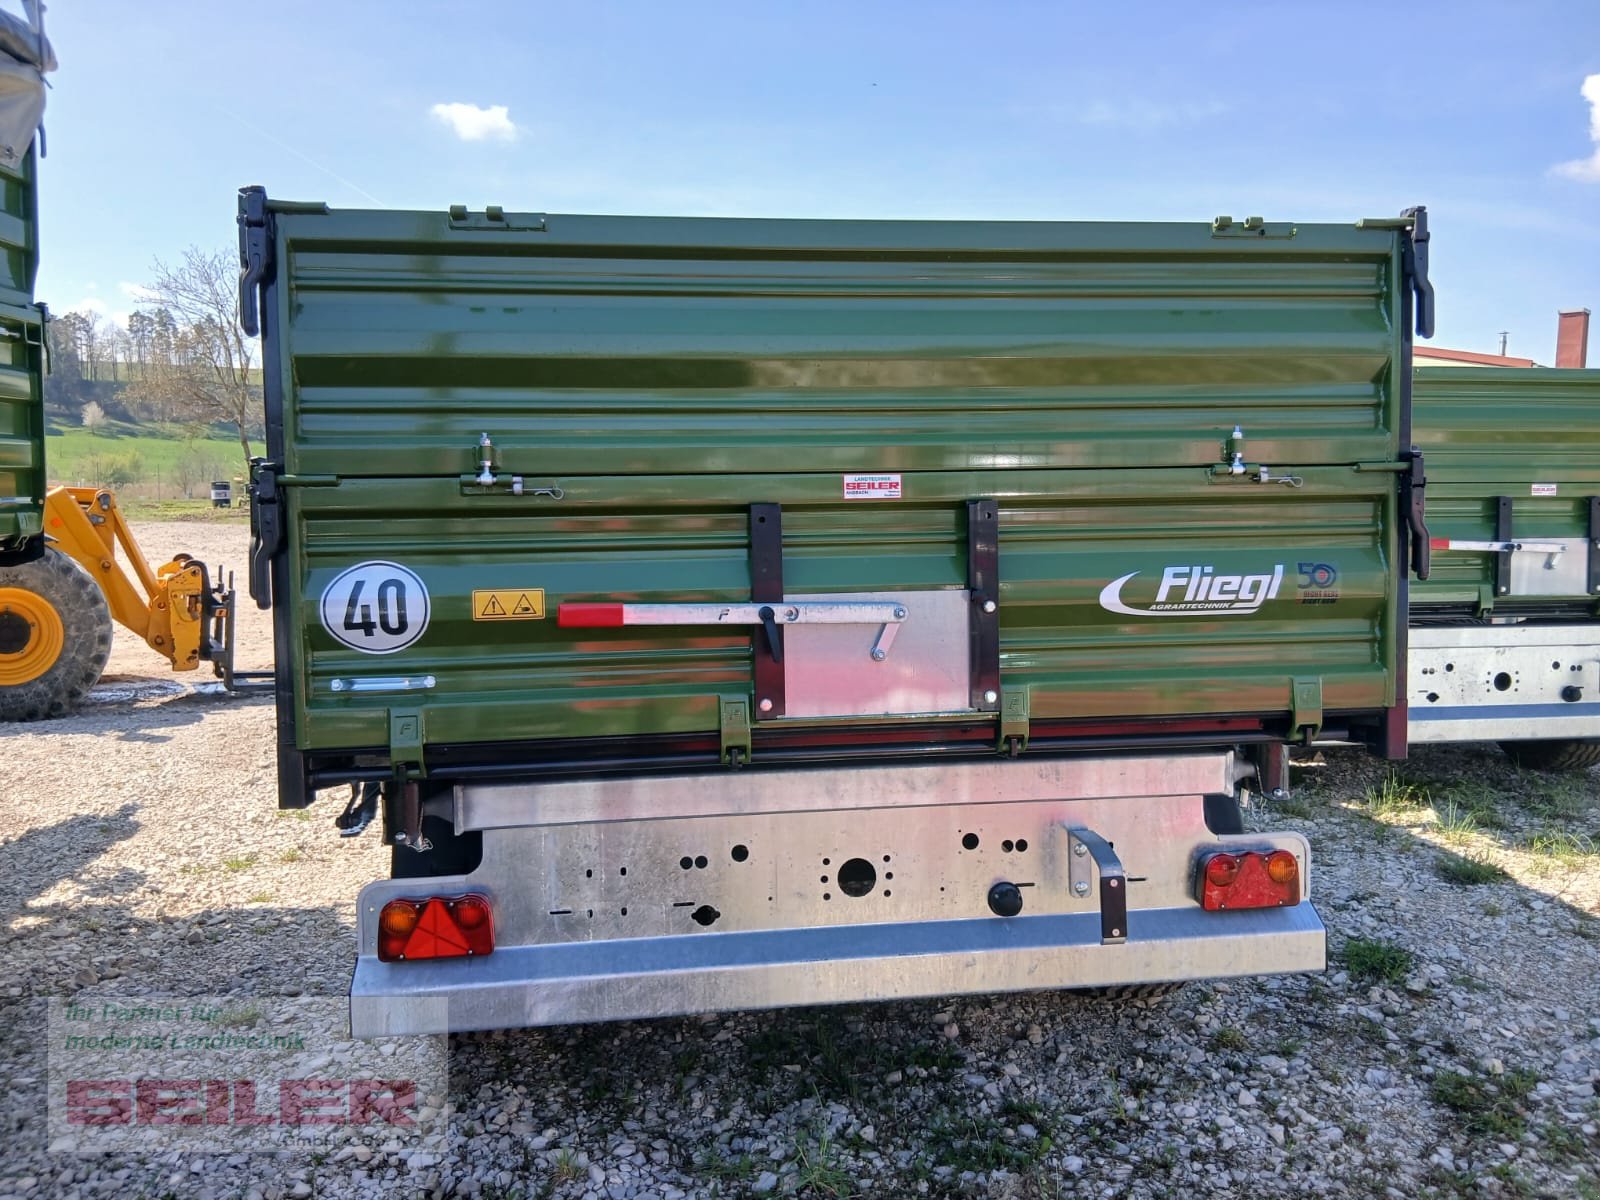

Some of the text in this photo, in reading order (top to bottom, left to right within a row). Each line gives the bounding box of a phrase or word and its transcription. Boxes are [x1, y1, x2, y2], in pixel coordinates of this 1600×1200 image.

[846, 482, 900, 490] SEILER
[1154, 564, 1284, 608] Fliegl
[1297, 562, 1337, 589] 50
[343, 578, 409, 637] 40
[1148, 602, 1232, 611] AGRARTECHNIK
